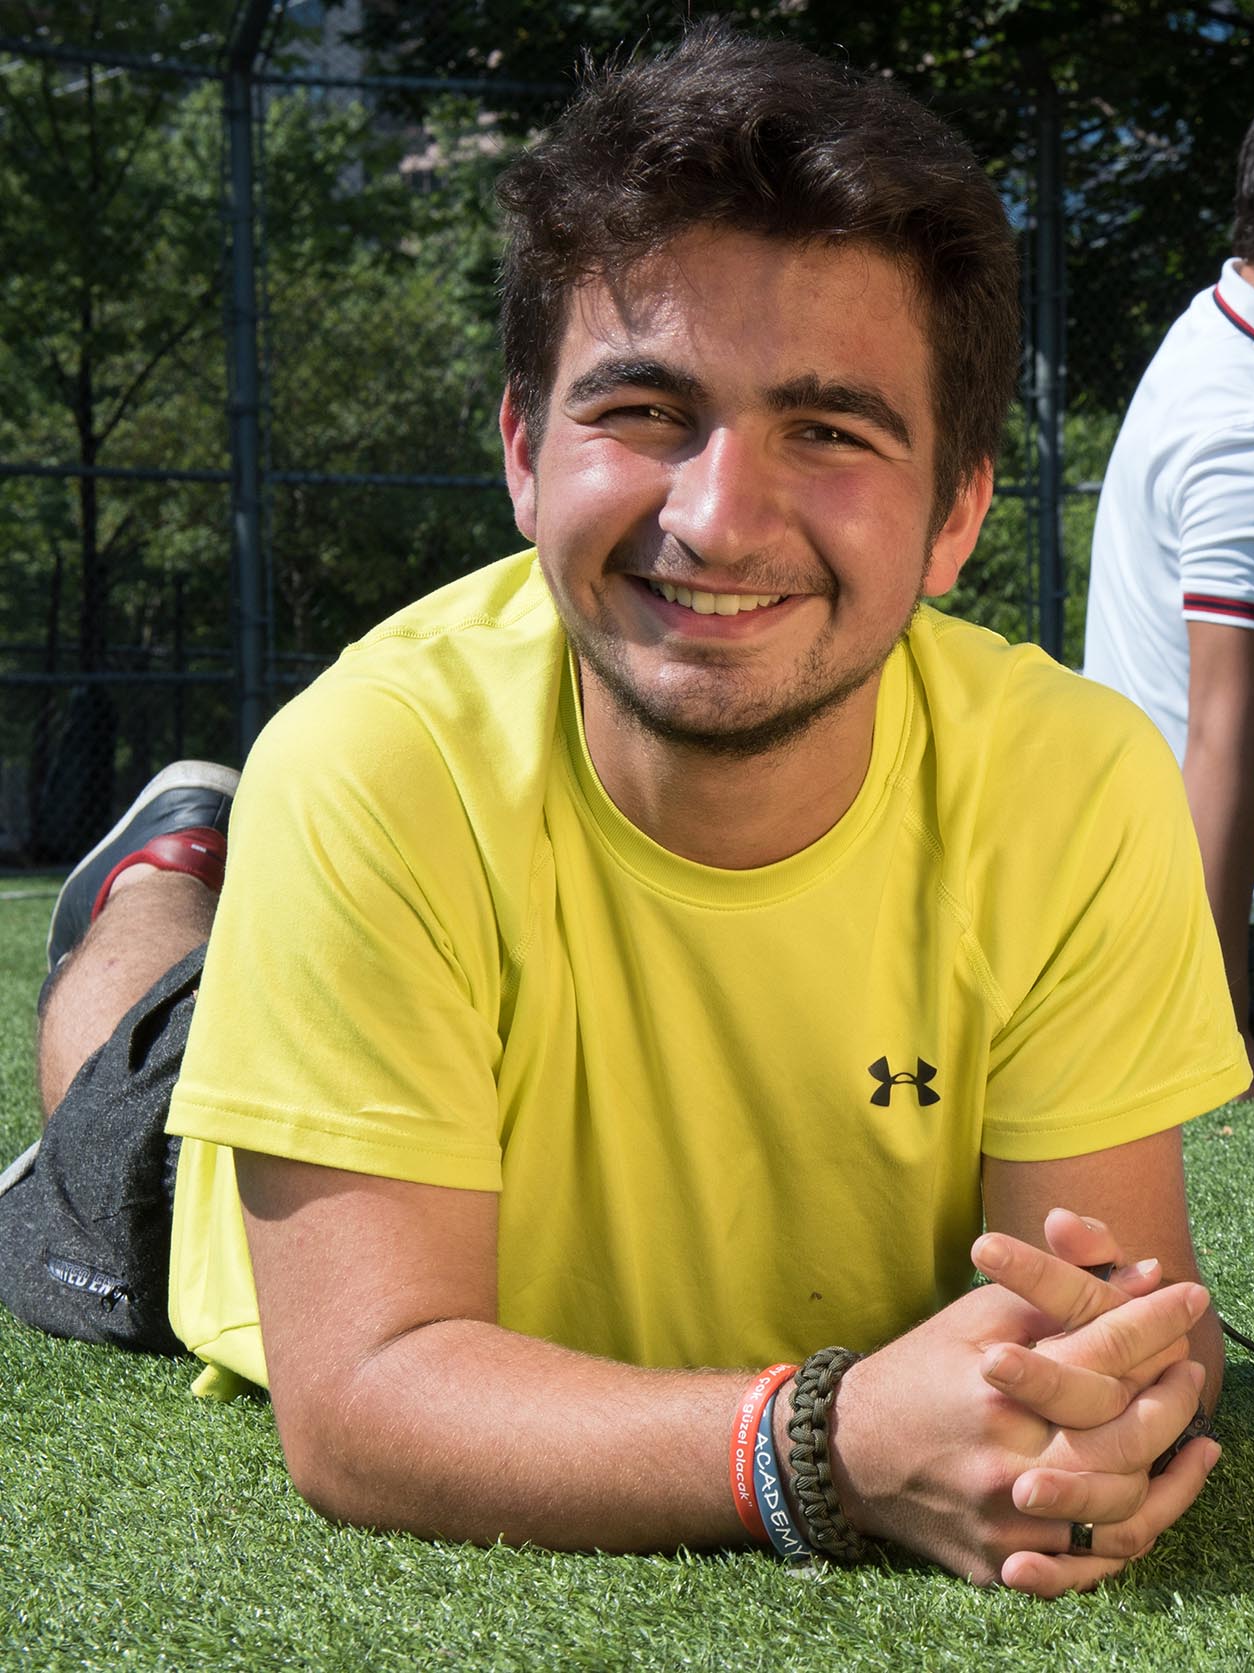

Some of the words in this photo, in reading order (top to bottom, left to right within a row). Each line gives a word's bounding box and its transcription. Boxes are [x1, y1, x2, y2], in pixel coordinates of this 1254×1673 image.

[750, 1377, 771, 1400] çok
[737, 1403, 754, 1445] güzel
[754, 1432, 812, 1557] ACADEMY
